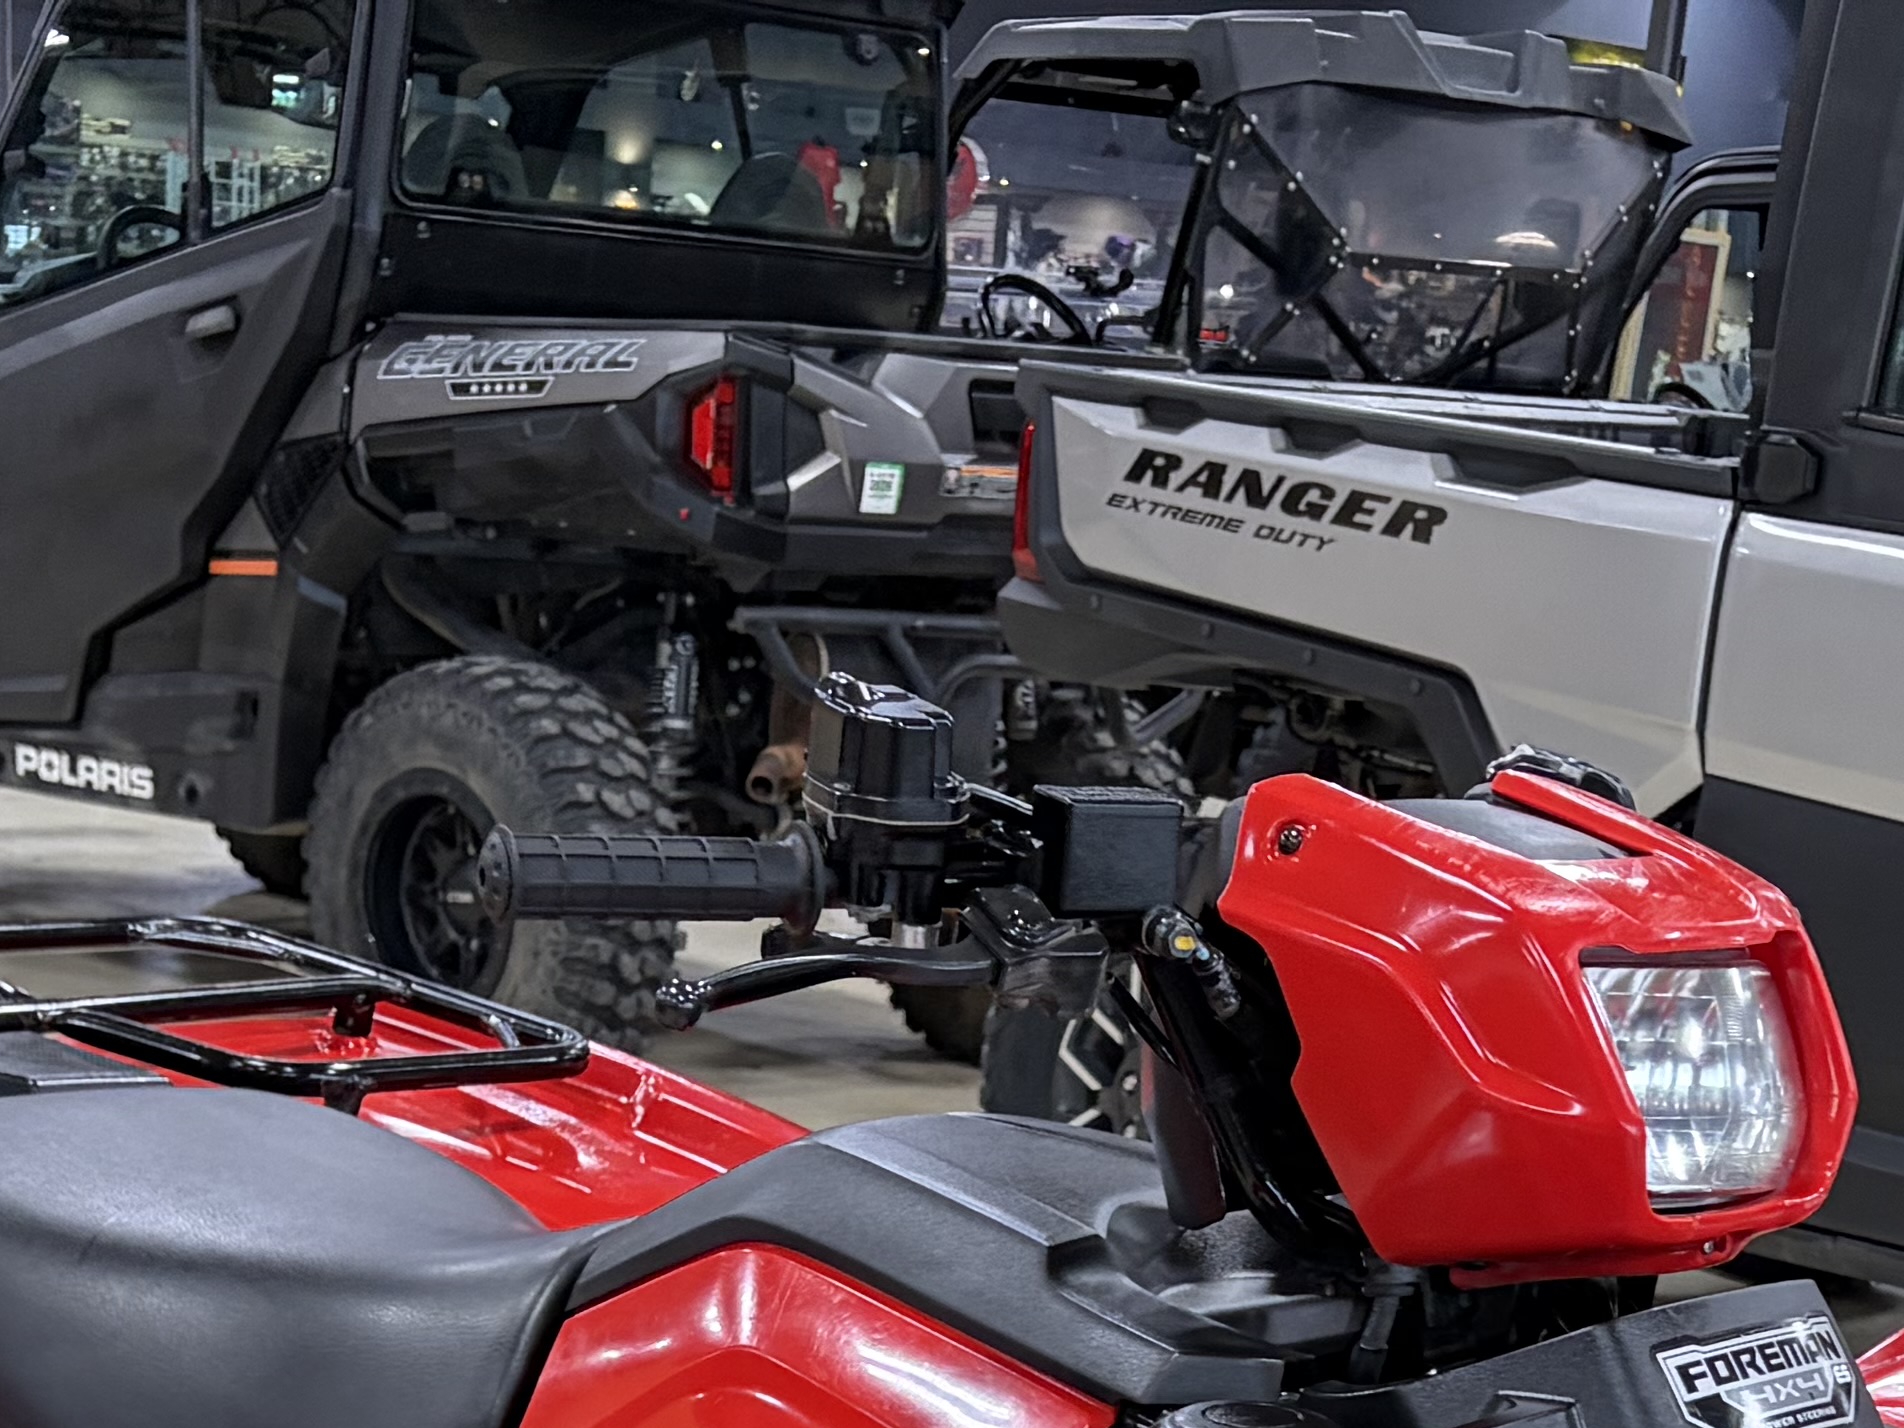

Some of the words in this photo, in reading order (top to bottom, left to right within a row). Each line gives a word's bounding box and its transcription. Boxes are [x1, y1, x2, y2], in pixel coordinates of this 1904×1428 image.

[376, 339, 648, 379] GENERAL
[1106, 493, 1246, 534] EXTREME
[1253, 524, 1338, 552] DUTY
[1123, 447, 1448, 545] RANGER
[14, 742, 155, 800] POLARIS
[1674, 1328, 1841, 1395] FOREMAN
